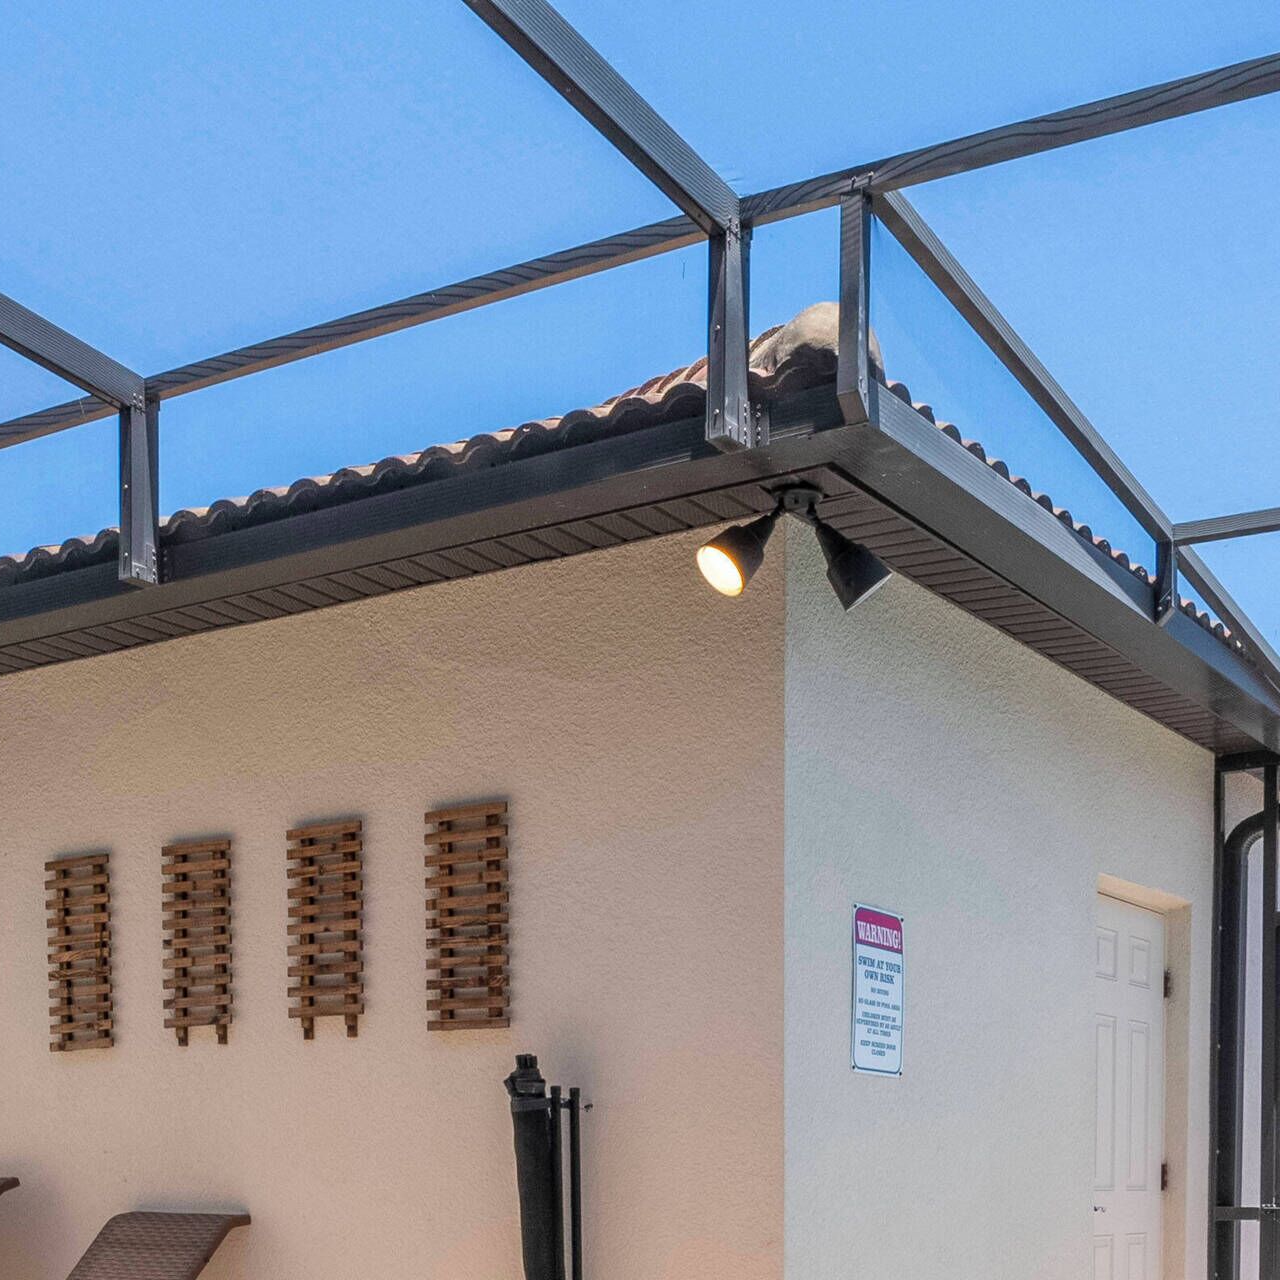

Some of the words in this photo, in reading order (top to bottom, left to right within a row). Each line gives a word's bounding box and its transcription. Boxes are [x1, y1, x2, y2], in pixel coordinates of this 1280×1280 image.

[856, 921, 901, 950] WARNING!
[858, 955, 875, 968] SWIM
[876, 960, 884, 969] AT
[885, 962, 901, 973] YOUR
[864, 969, 879, 981] OWN
[880, 973, 894, 984] RISK
